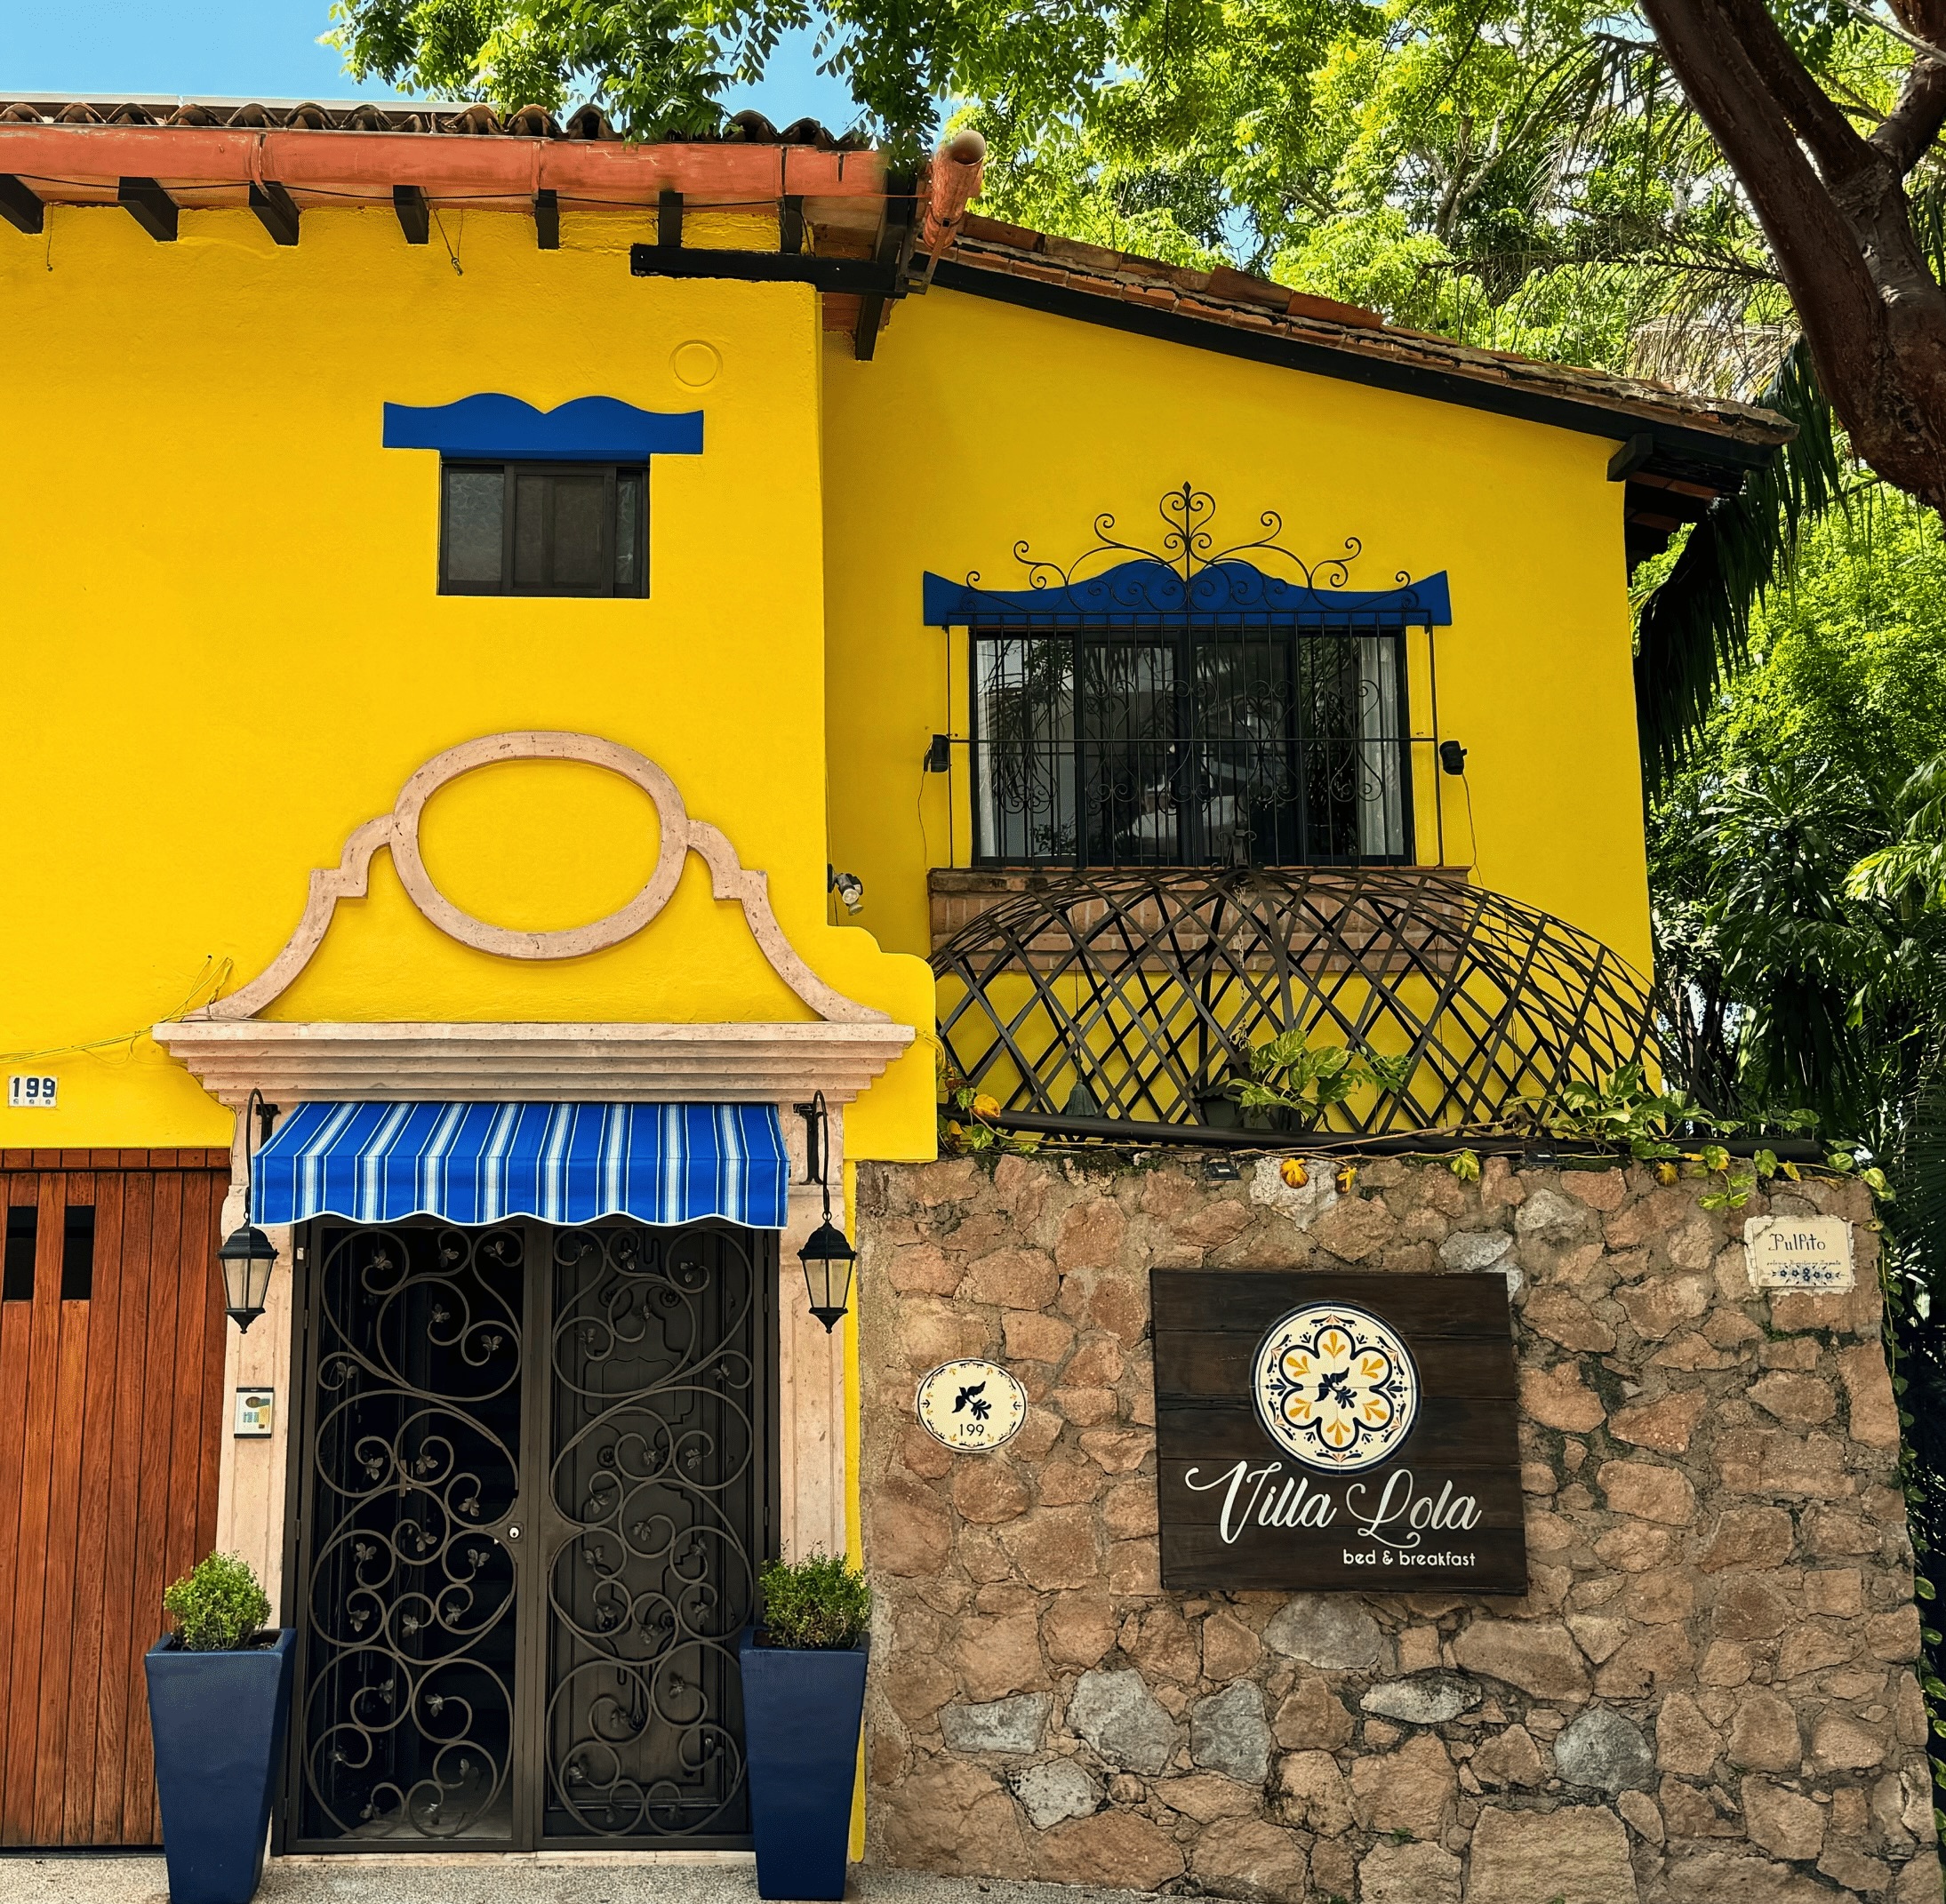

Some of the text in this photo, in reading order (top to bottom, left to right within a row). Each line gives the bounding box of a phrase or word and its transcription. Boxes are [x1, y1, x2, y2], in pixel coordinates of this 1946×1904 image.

[13, 1077, 55, 1098] 199
[960, 1424, 984, 1436] 199
[1185, 1460, 1482, 1548] Villa Lola
[1343, 1549, 1476, 1566] bed & breakfast
